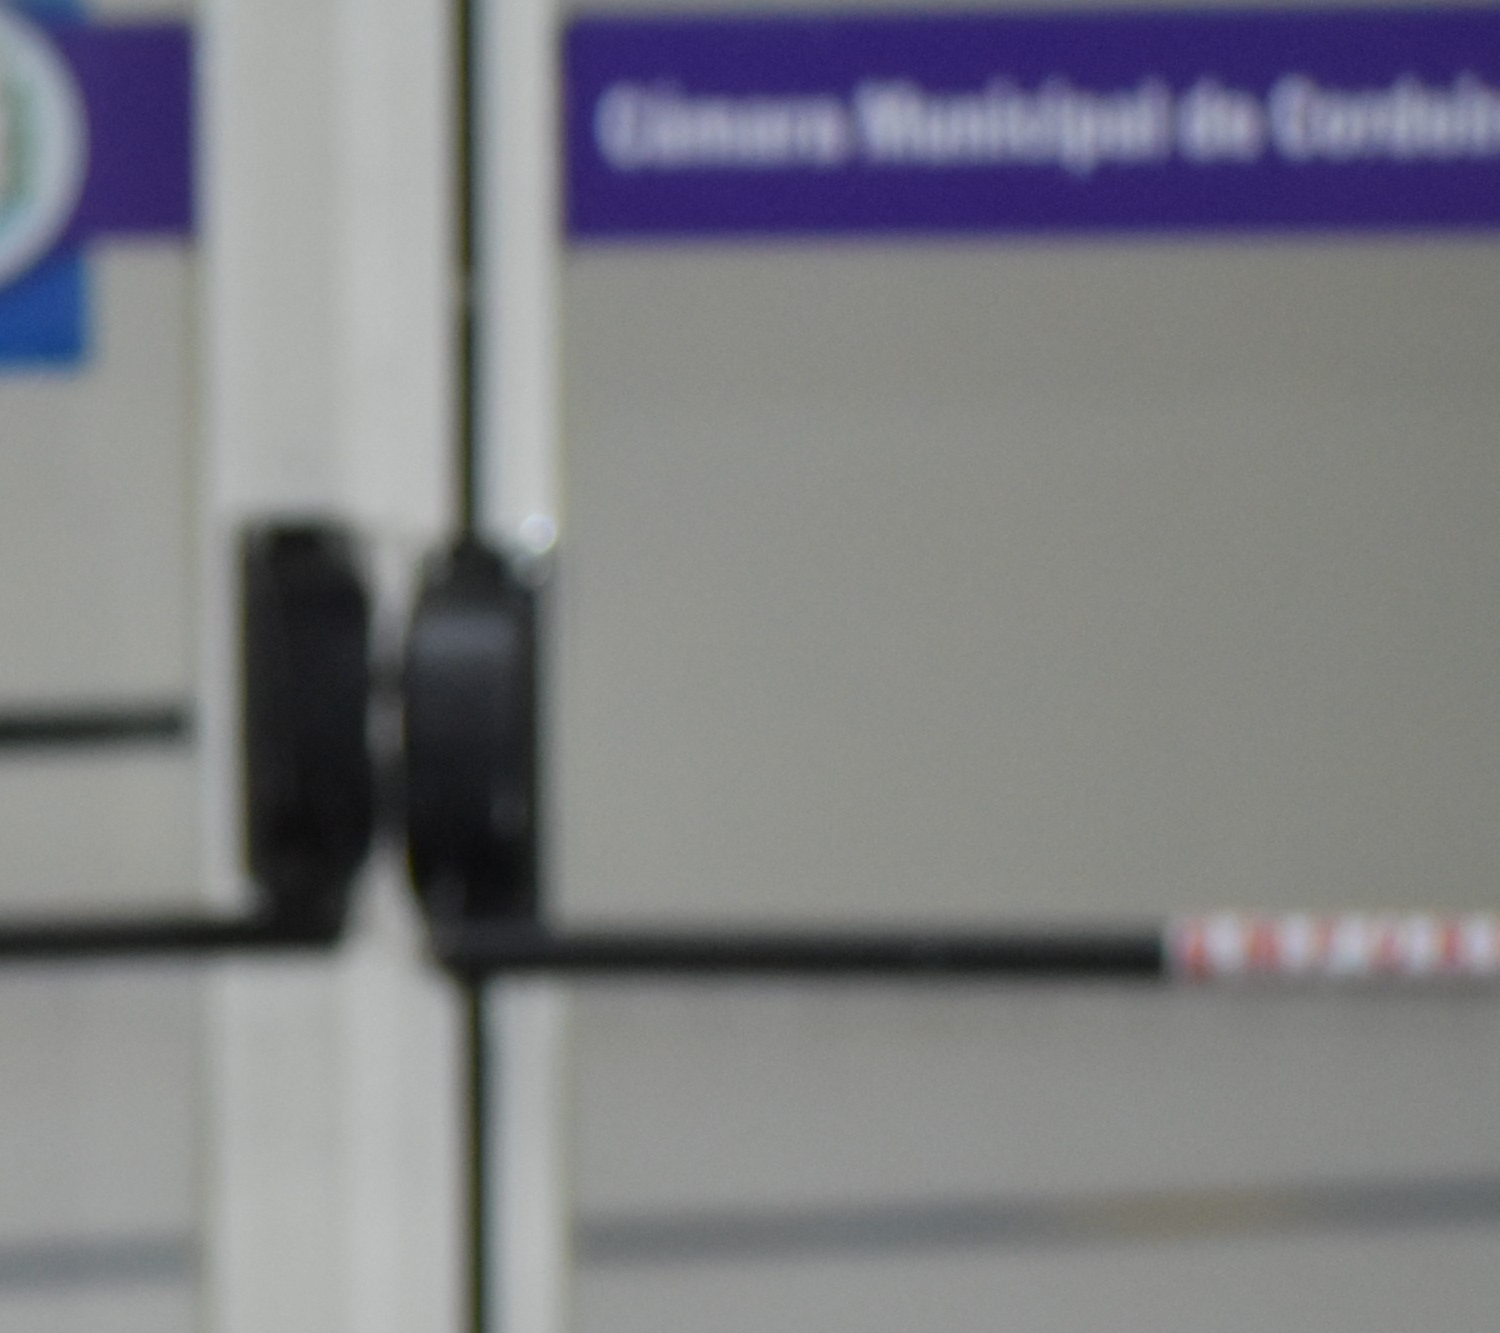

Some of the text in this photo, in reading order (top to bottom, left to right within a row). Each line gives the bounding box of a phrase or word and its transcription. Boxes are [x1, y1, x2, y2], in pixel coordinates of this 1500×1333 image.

[598, 78, 850, 172] Câmara
[853, 74, 1168, 176] Municipal
[1176, 76, 1264, 165] de
